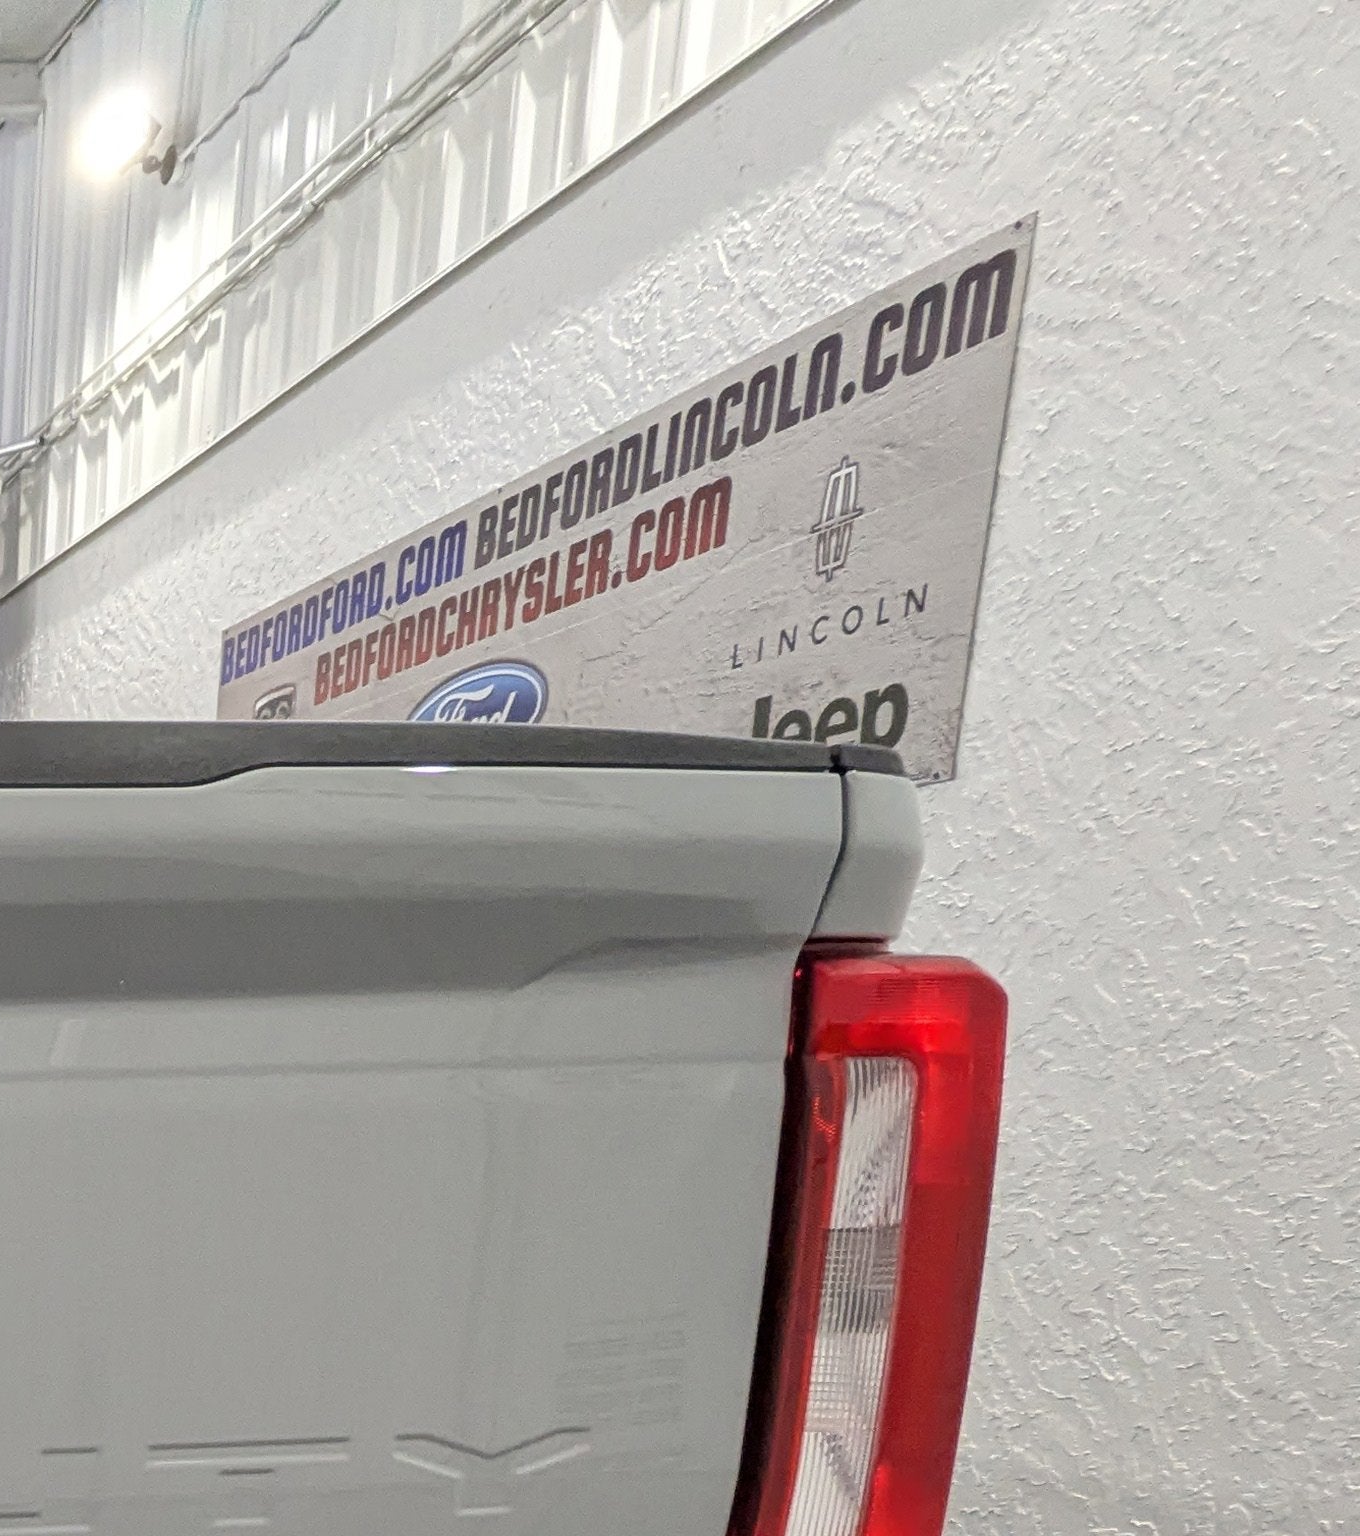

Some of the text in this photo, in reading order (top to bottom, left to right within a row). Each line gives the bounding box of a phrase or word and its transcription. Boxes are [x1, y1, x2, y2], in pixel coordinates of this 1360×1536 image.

[220, 247, 1018, 687] BEDFORDFORD.COM BEDFORDLINCOLN.COM
[313, 475, 733, 706] BEDFORDCHRYSLER.COM
[731, 582, 929, 670] LINCOLN
